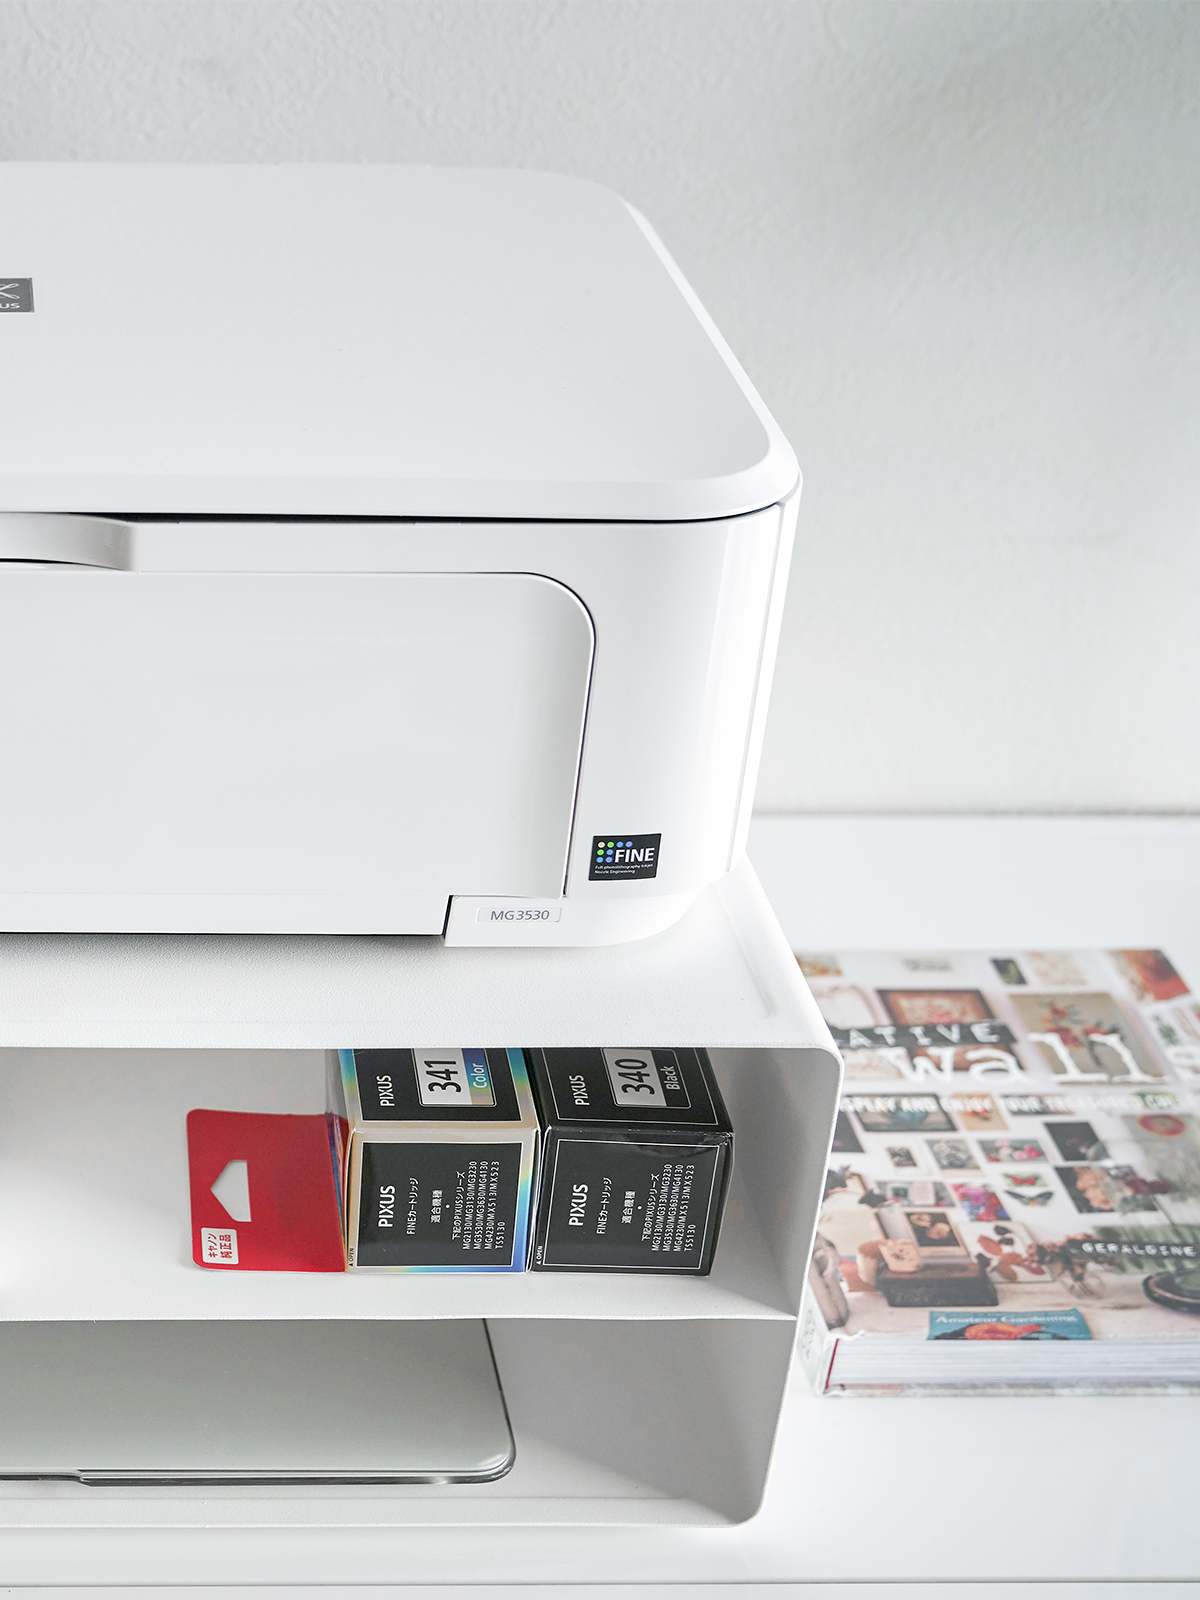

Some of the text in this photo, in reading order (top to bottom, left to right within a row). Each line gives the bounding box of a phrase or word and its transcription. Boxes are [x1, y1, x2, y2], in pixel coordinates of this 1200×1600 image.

[614, 847, 655, 863] FINE
[490, 909, 550, 921] MG3530
[471, 1062, 487, 1089] Color
[880, 1032, 1168, 1084] wall
[377, 1073, 396, 1107] PIXUS
[424, 1059, 462, 1094] 341
[569, 1074, 590, 1106] PIXUS
[614, 1058, 655, 1095] 340
[660, 1065, 681, 1090] Black
[377, 1183, 397, 1228] PIXUS
[406, 1177, 419, 1235] FINEカートリッジ
[430, 1189, 443, 1223] 適合機種
[451, 1171, 466, 1240] 下記のPIXUSシリーズ
[462, 1160, 478, 1250] MG2130/MG3130/MG3230
[473, 1160, 489, 1250] MG3530/MG3630/MG4130
[568, 1183, 589, 1226] PIXUS
[596, 1177, 612, 1235] FINEカートリッジ
[621, 1190, 636, 1224] 適合機種
[641, 1173, 659, 1241] 下記のPIXUSシリーズ
[651, 1163, 673, 1252] MG2130/MG3130/MG3230
[662, 1164, 684, 1252] MG3530/MG3630/MG4130
[219, 1233, 232, 1259] 純正品
[495, 1221, 506, 1249] TS5130
[684, 1224, 697, 1252] TS5130
[1081, 1242, 1197, 1257] GERALDINE
